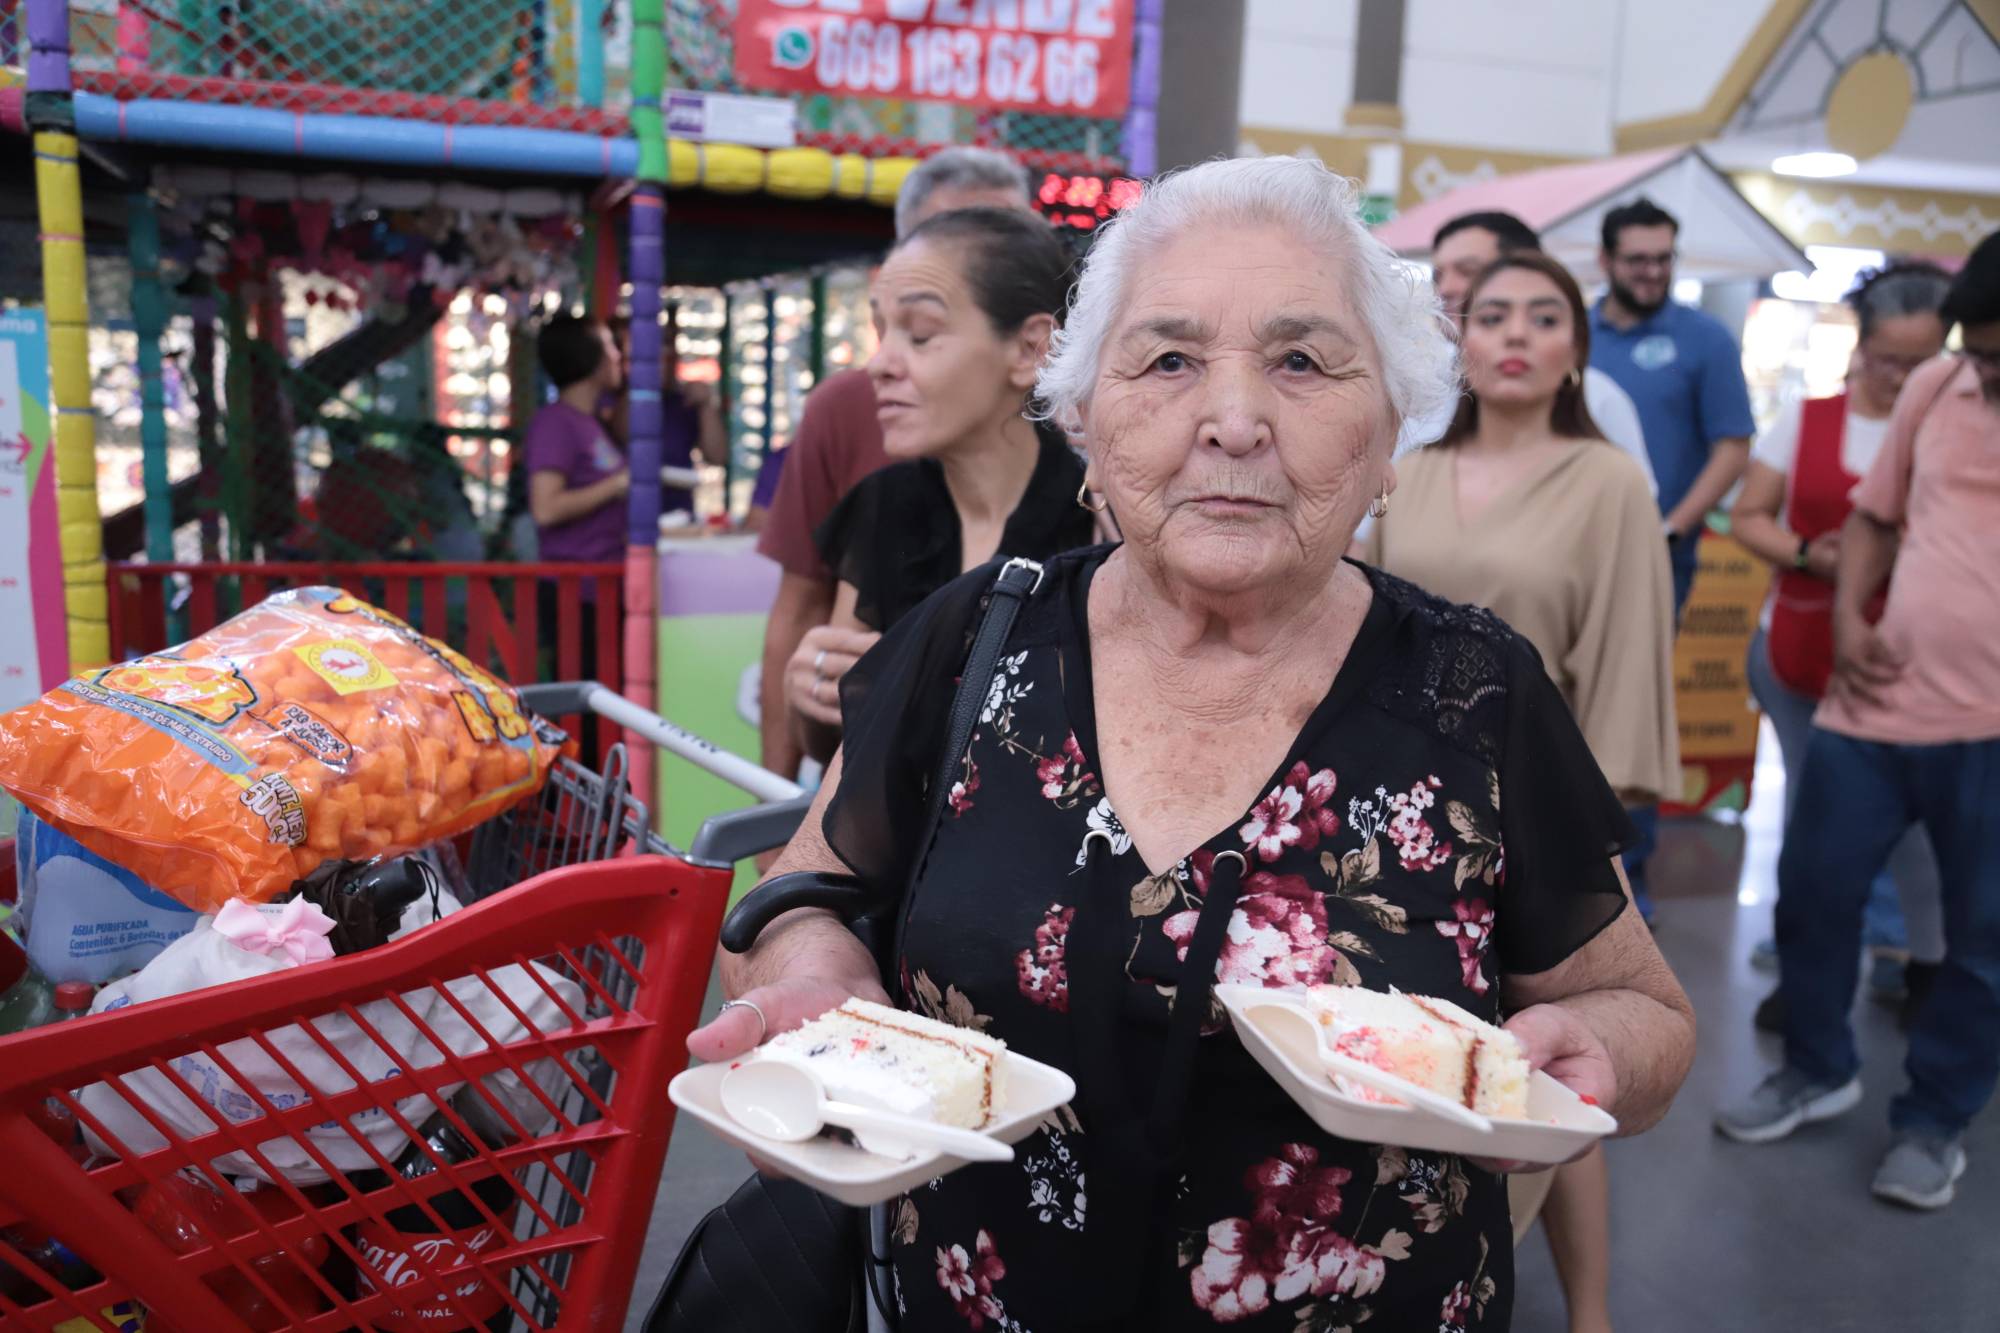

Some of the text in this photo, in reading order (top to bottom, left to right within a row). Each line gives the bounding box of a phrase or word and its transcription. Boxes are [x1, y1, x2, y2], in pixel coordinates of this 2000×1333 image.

[815, 17, 1100, 108] 669 163 62 66
[154, 712, 170, 728] DE
[187, 729, 232, 762] EXTRUIDO
[72, 919, 149, 936] AGUA PURIFICADA
